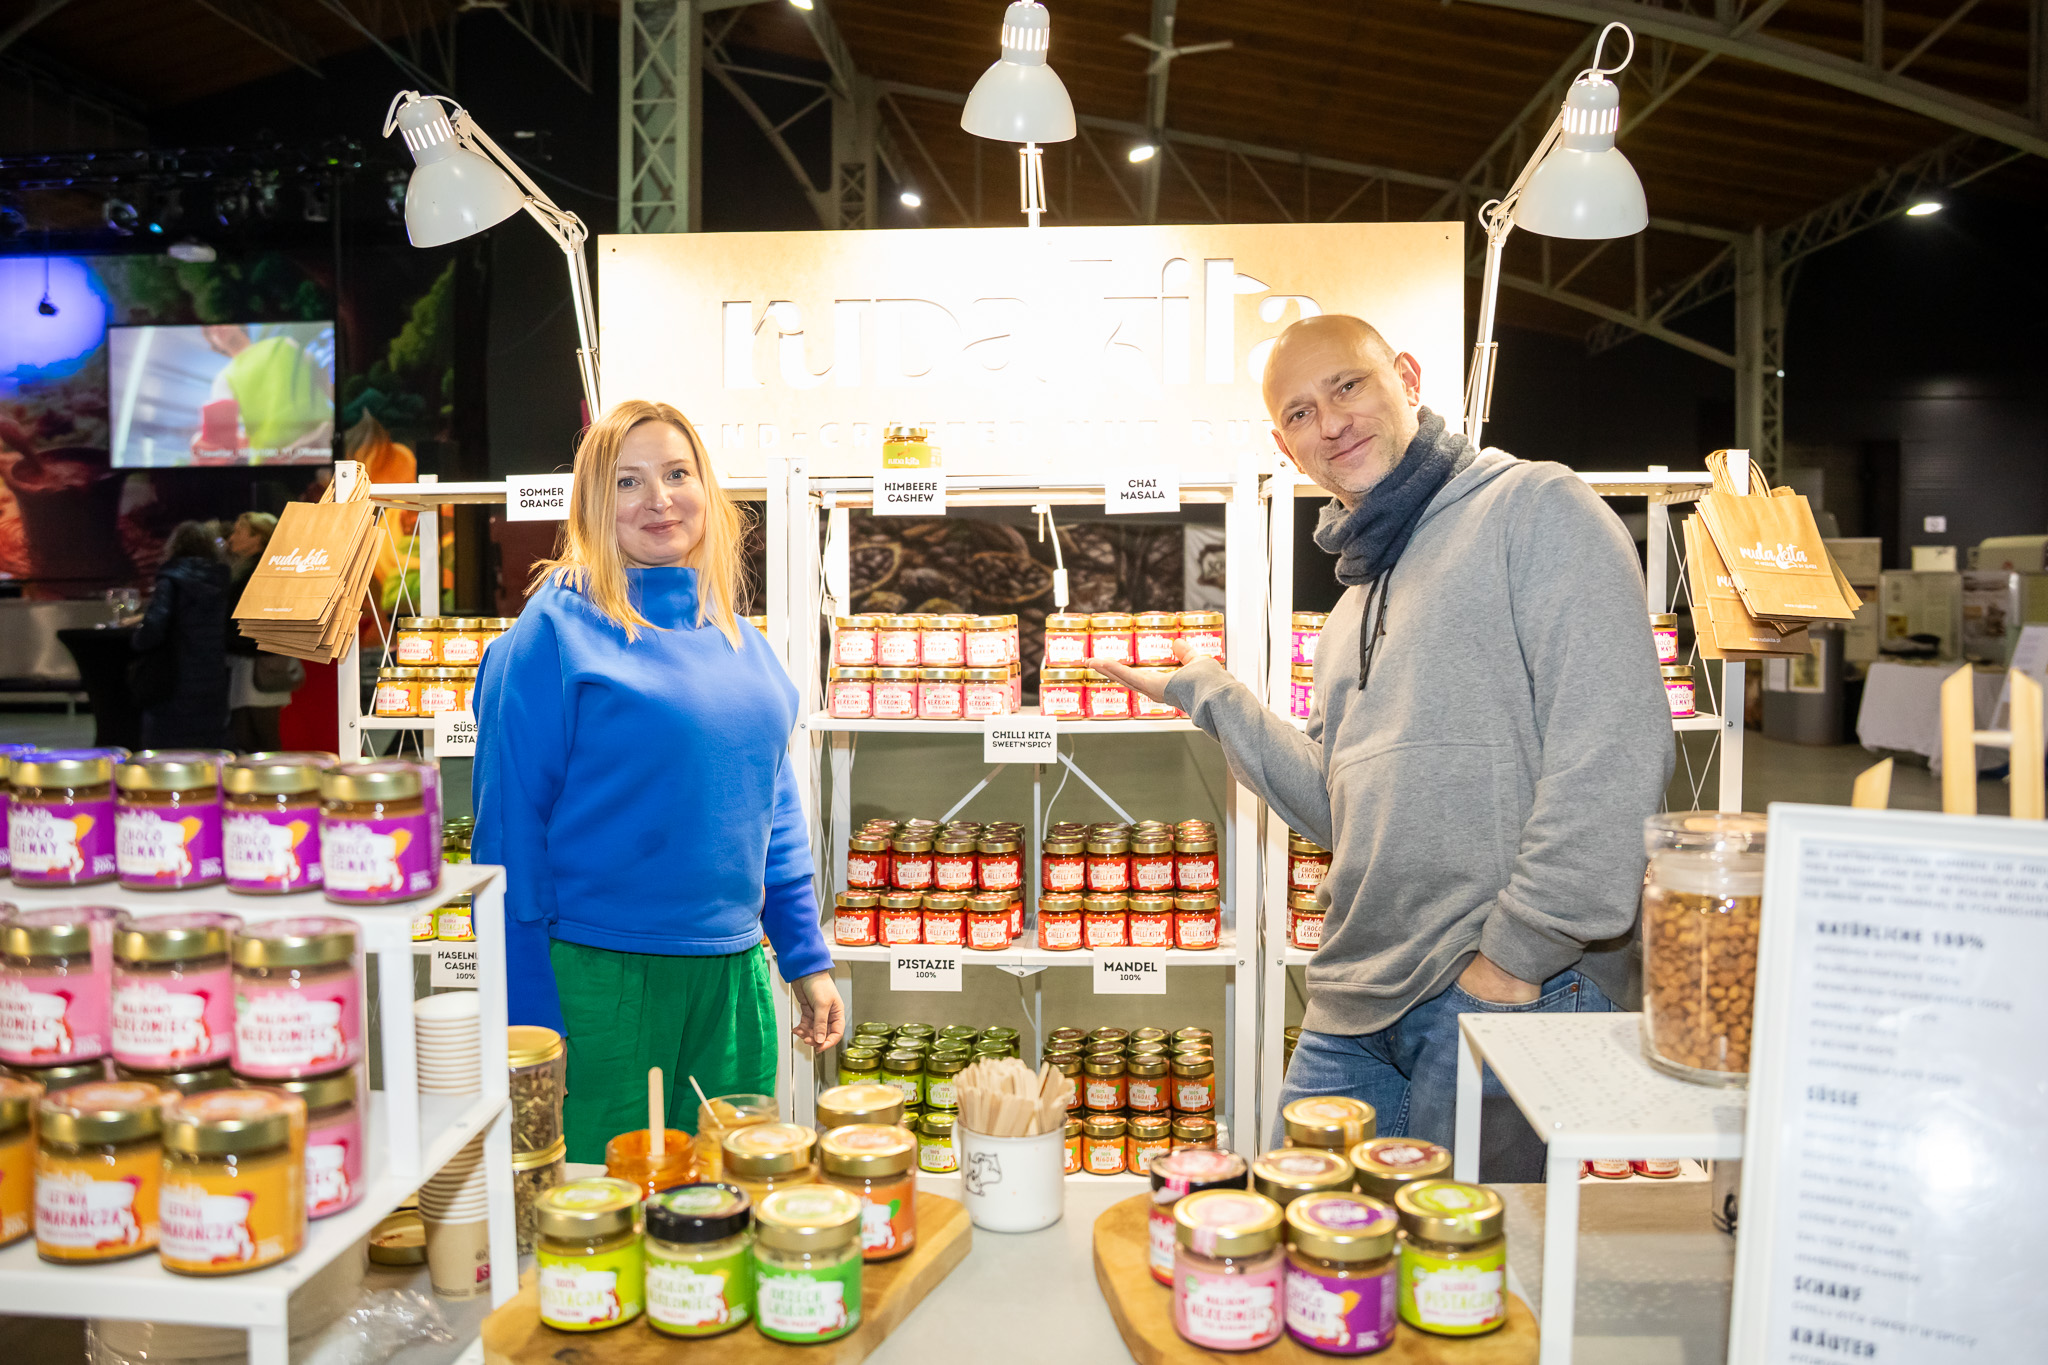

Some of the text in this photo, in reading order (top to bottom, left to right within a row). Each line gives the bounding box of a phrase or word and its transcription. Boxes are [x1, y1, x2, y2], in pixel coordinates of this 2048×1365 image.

[884, 482, 938, 491] HIMBEERE
[1128, 479, 1157, 488] CHAI
[519, 487, 564, 497] SOMMER
[1120, 490, 1166, 500] MASALA
[887, 493, 934, 502] CASHEW
[520, 498, 564, 508] ORANGE
[1740, 541, 1776, 560] ruda
[268, 547, 302, 565] ruda
[1716, 575, 1735, 587] ru
[453, 721, 478, 732] SÜSS
[447, 735, 477, 743] PISTA
[992, 731, 1052, 739] CHILLI KITA
[992, 740, 1052, 748] SWEET'N'SPICY
[445, 962, 477, 970] CASHE
[897, 959, 955, 970] PISTAZIE
[1104, 961, 1158, 972] MANDEL
[915, 971, 937, 979] 100%
